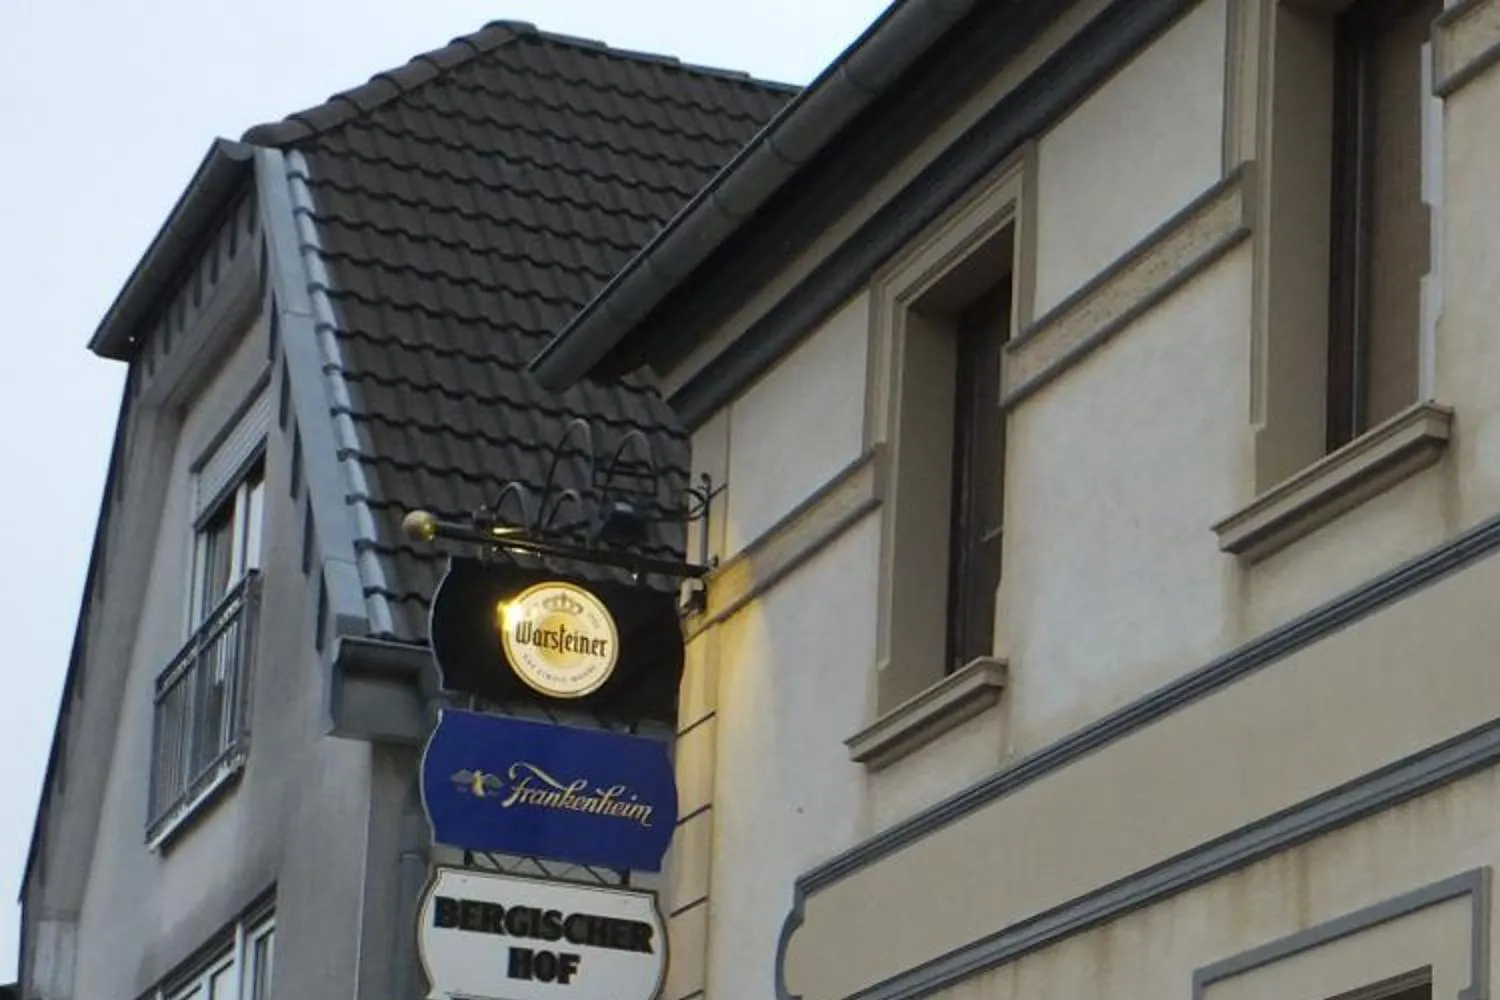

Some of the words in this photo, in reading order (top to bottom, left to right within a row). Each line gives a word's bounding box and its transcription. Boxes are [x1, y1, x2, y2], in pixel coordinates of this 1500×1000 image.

[515, 620, 608, 657] Warsteiner
[502, 761, 653, 828] Frankenheim
[433, 896, 654, 955] BERGISCHER
[507, 946, 581, 985] HOF
